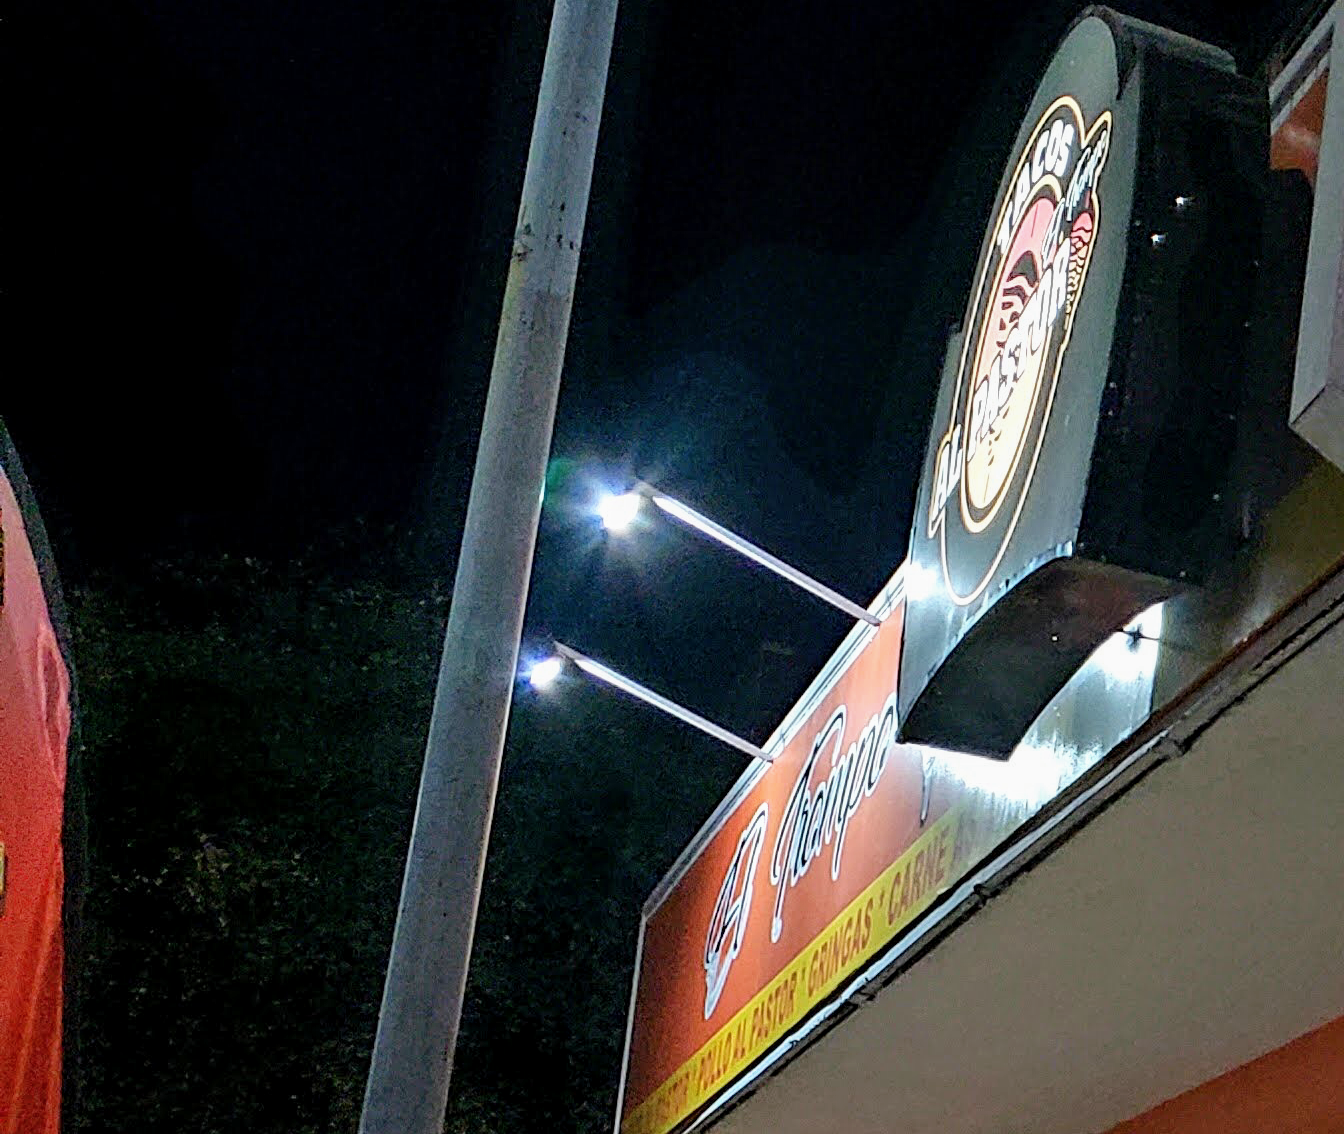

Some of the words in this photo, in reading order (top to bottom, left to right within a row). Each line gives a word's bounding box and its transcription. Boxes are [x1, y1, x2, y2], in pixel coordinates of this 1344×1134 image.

[996, 118, 1075, 254] TACOS
[931, 423, 963, 519] AL
[967, 237, 1070, 463] PASTOR
[749, 970, 798, 1050] PASTOR
[807, 896, 873, 998] GRINGAS
[887, 824, 950, 927] CARNE
